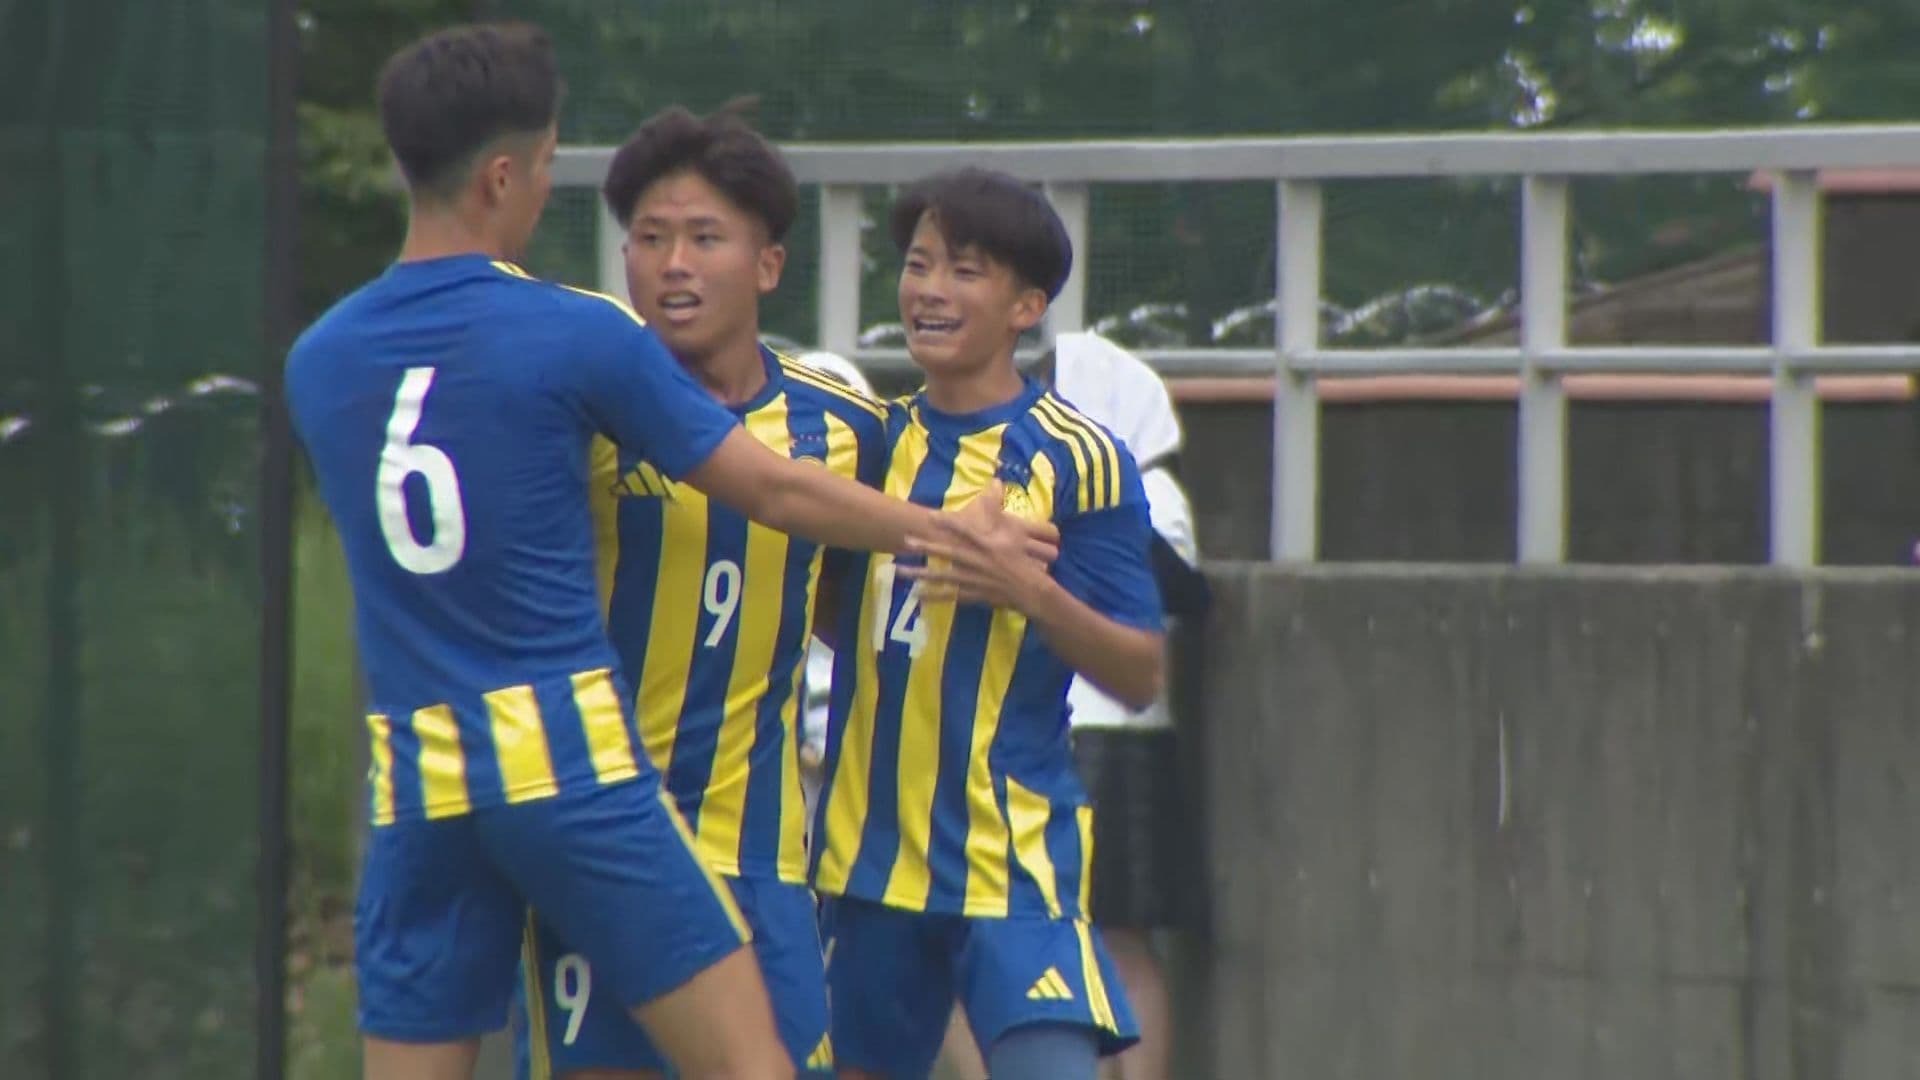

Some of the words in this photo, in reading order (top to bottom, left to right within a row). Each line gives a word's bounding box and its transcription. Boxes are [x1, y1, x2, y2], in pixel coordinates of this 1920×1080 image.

[376, 366, 465, 574] 6
[703, 560, 742, 648] 9
[873, 554, 928, 659] 14
[555, 955, 591, 1045] 9
